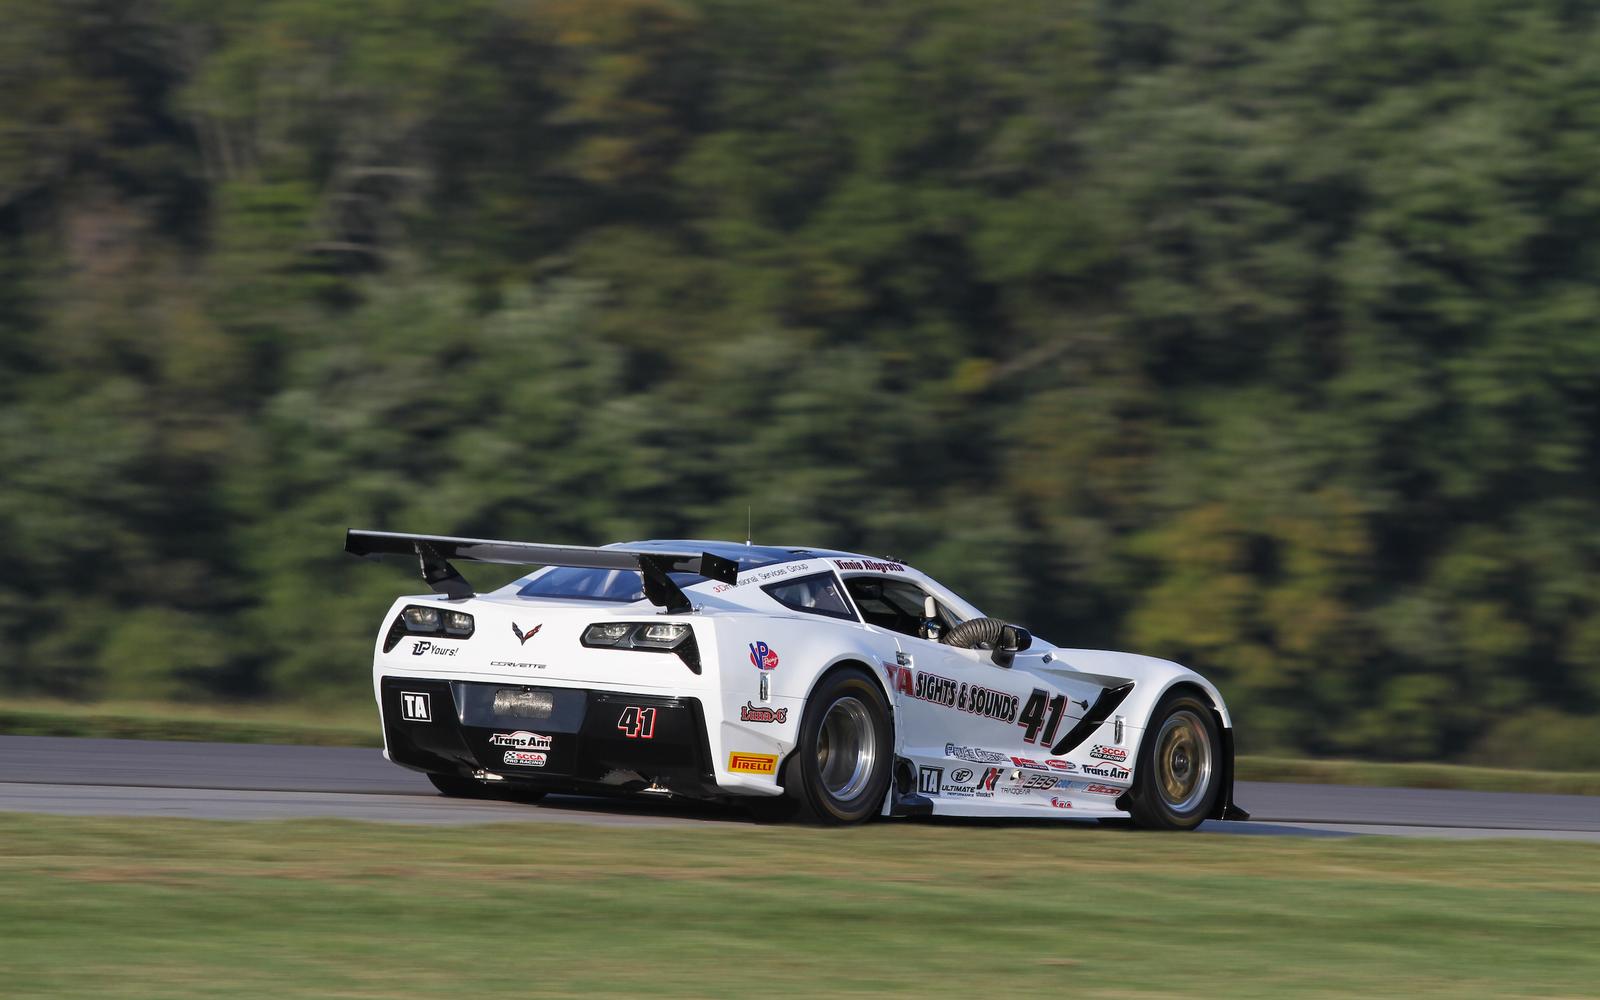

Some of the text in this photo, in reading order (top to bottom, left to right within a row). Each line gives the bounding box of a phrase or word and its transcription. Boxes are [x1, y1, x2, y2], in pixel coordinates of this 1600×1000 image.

[786, 563, 809, 573] Group
[430, 645, 459, 657] Yours!
[749, 640, 769, 670] VP
[490, 661, 547, 669] CORVETTE
[883, 661, 1020, 724] TA SIGHTS & SOUNDS
[404, 695, 428, 719] TA
[617, 706, 657, 739] 41
[1018, 687, 1068, 749] 41
[493, 734, 550, 748] Trans Am
[1102, 747, 1126, 756] SCCA
[1102, 754, 1125, 762] RACING
[731, 755, 774, 771] PIRELLI
[1081, 764, 1109, 777] Trans
[1109, 767, 1129, 779] Am
[921, 769, 940, 793] TA
[941, 785, 975, 793] ULTIMATE
